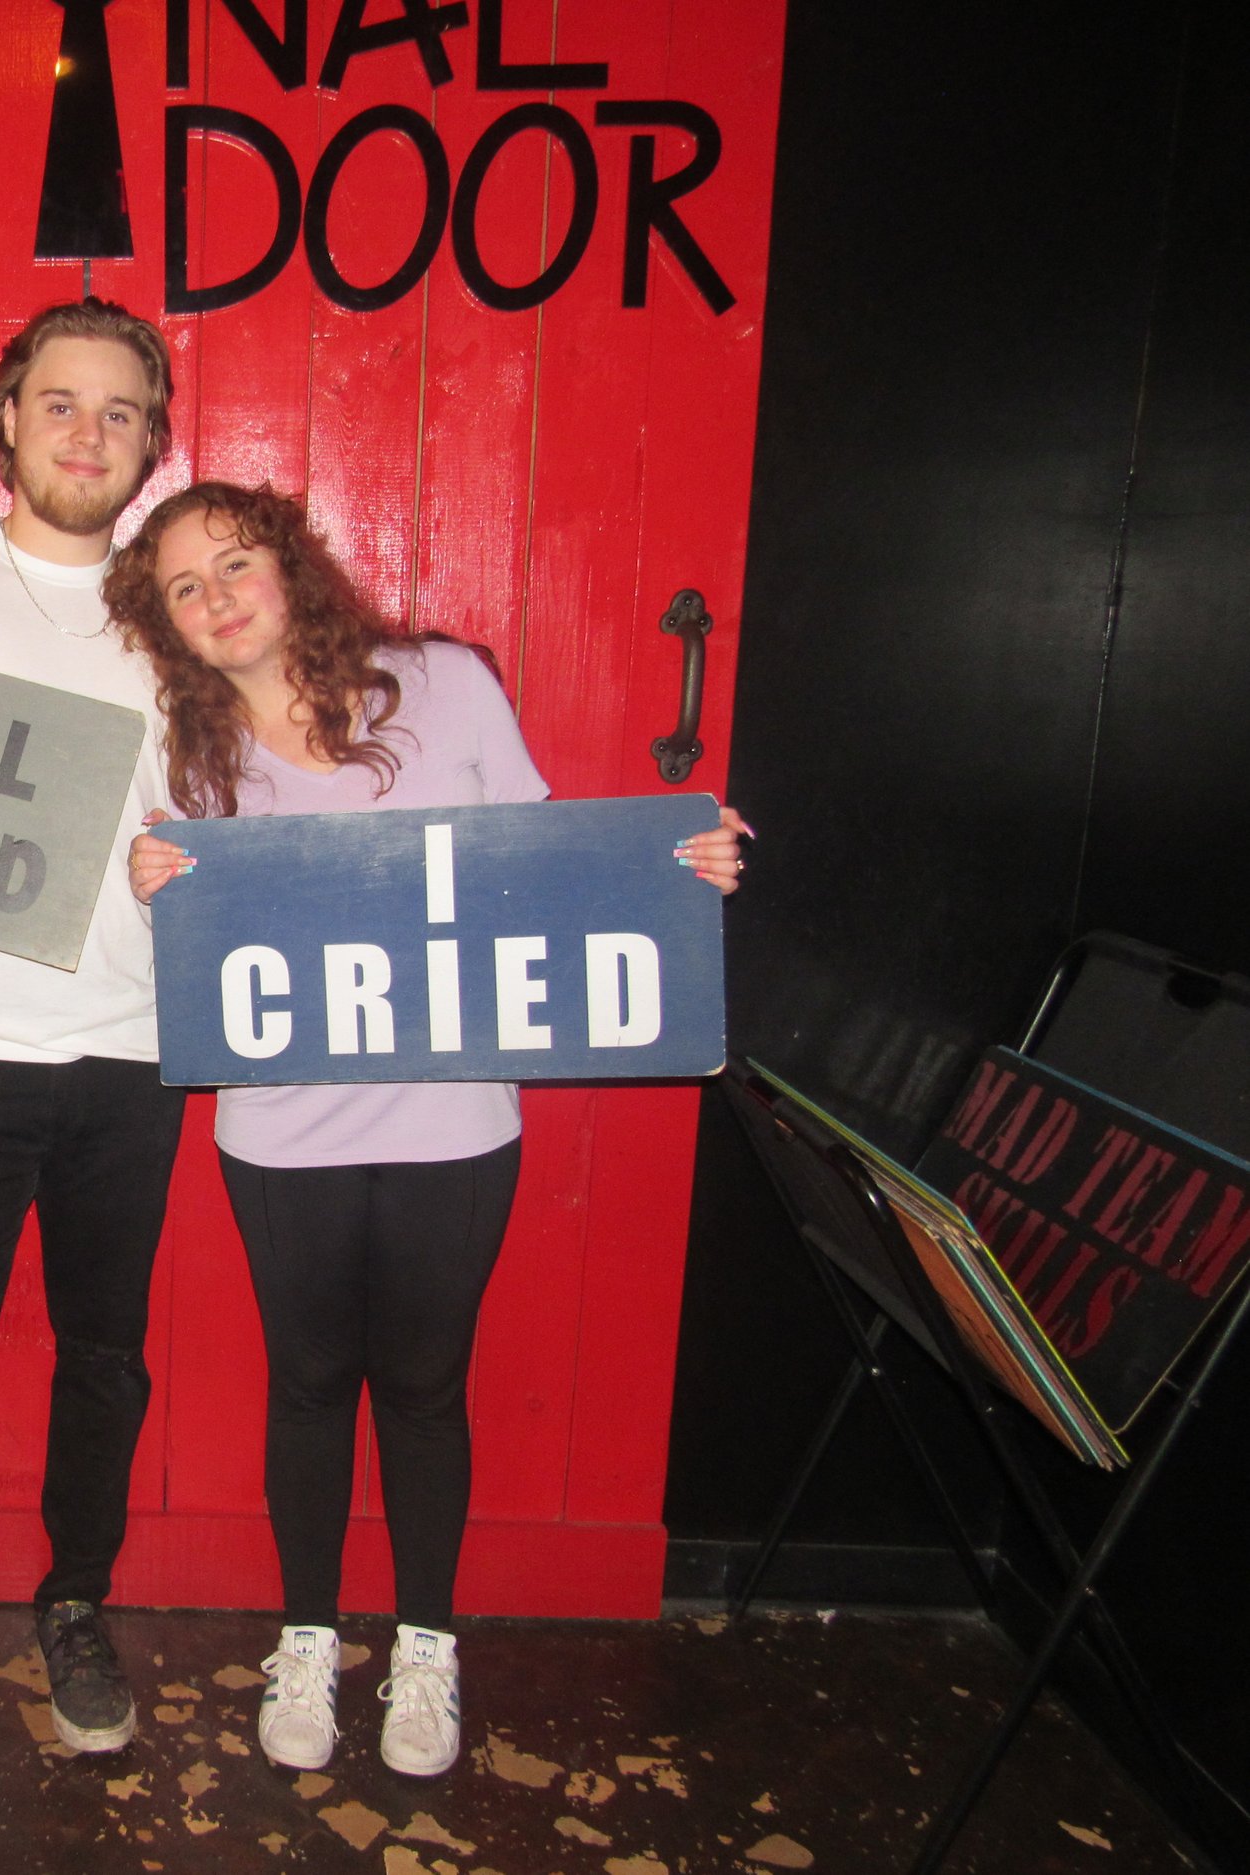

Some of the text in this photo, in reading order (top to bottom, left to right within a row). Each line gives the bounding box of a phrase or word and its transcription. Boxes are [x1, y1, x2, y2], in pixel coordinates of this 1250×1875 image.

[165, 99, 738, 318] DOOR
[424, 824, 455, 924] I
[220, 932, 662, 1060] CRIED
[943, 1060, 1250, 1299] MAD TEAM
